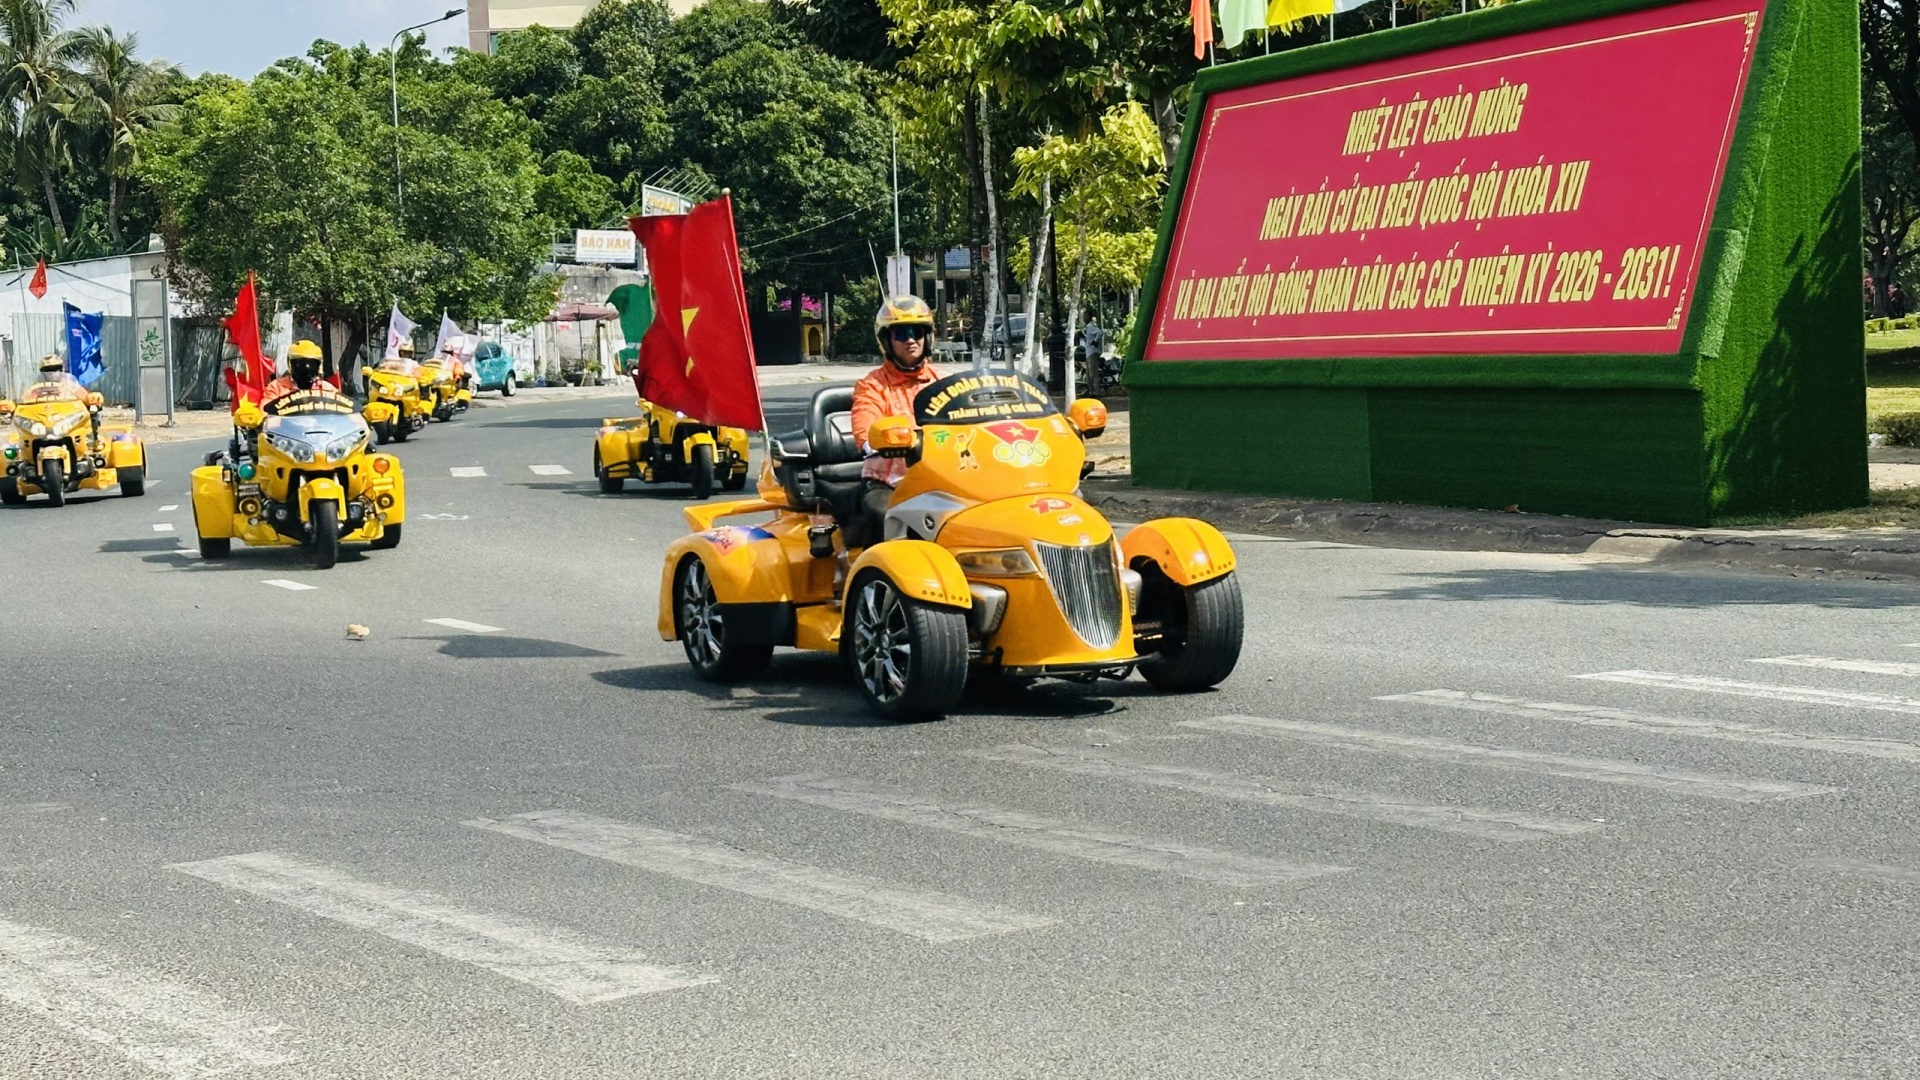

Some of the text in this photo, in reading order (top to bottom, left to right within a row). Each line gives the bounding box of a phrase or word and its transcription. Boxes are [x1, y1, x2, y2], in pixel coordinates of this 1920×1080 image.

[1342, 76, 1528, 162] NHIỆT LIỆT CHÀO MỪNG
[1259, 154, 1590, 241] NGÀY BẦU CỬ ĐẠI BIỂU QUỐC HỘI KHÓA XVI
[606, 238, 631, 249] NAM
[1173, 241, 1681, 329] VÀ ĐẠI BIỂU HỘI ĐỒNG NHÂN DÂN CÁC CẤP NHIỆM KỲ 2026 - 2031!
[925, 391, 951, 416] LIÊN
[946, 377, 981, 398] ĐOÀN
[980, 375, 998, 387] XE
[1022, 381, 1048, 404] THAO
[948, 407, 979, 420] THÀNH
[978, 405, 998, 416] PHỐ
